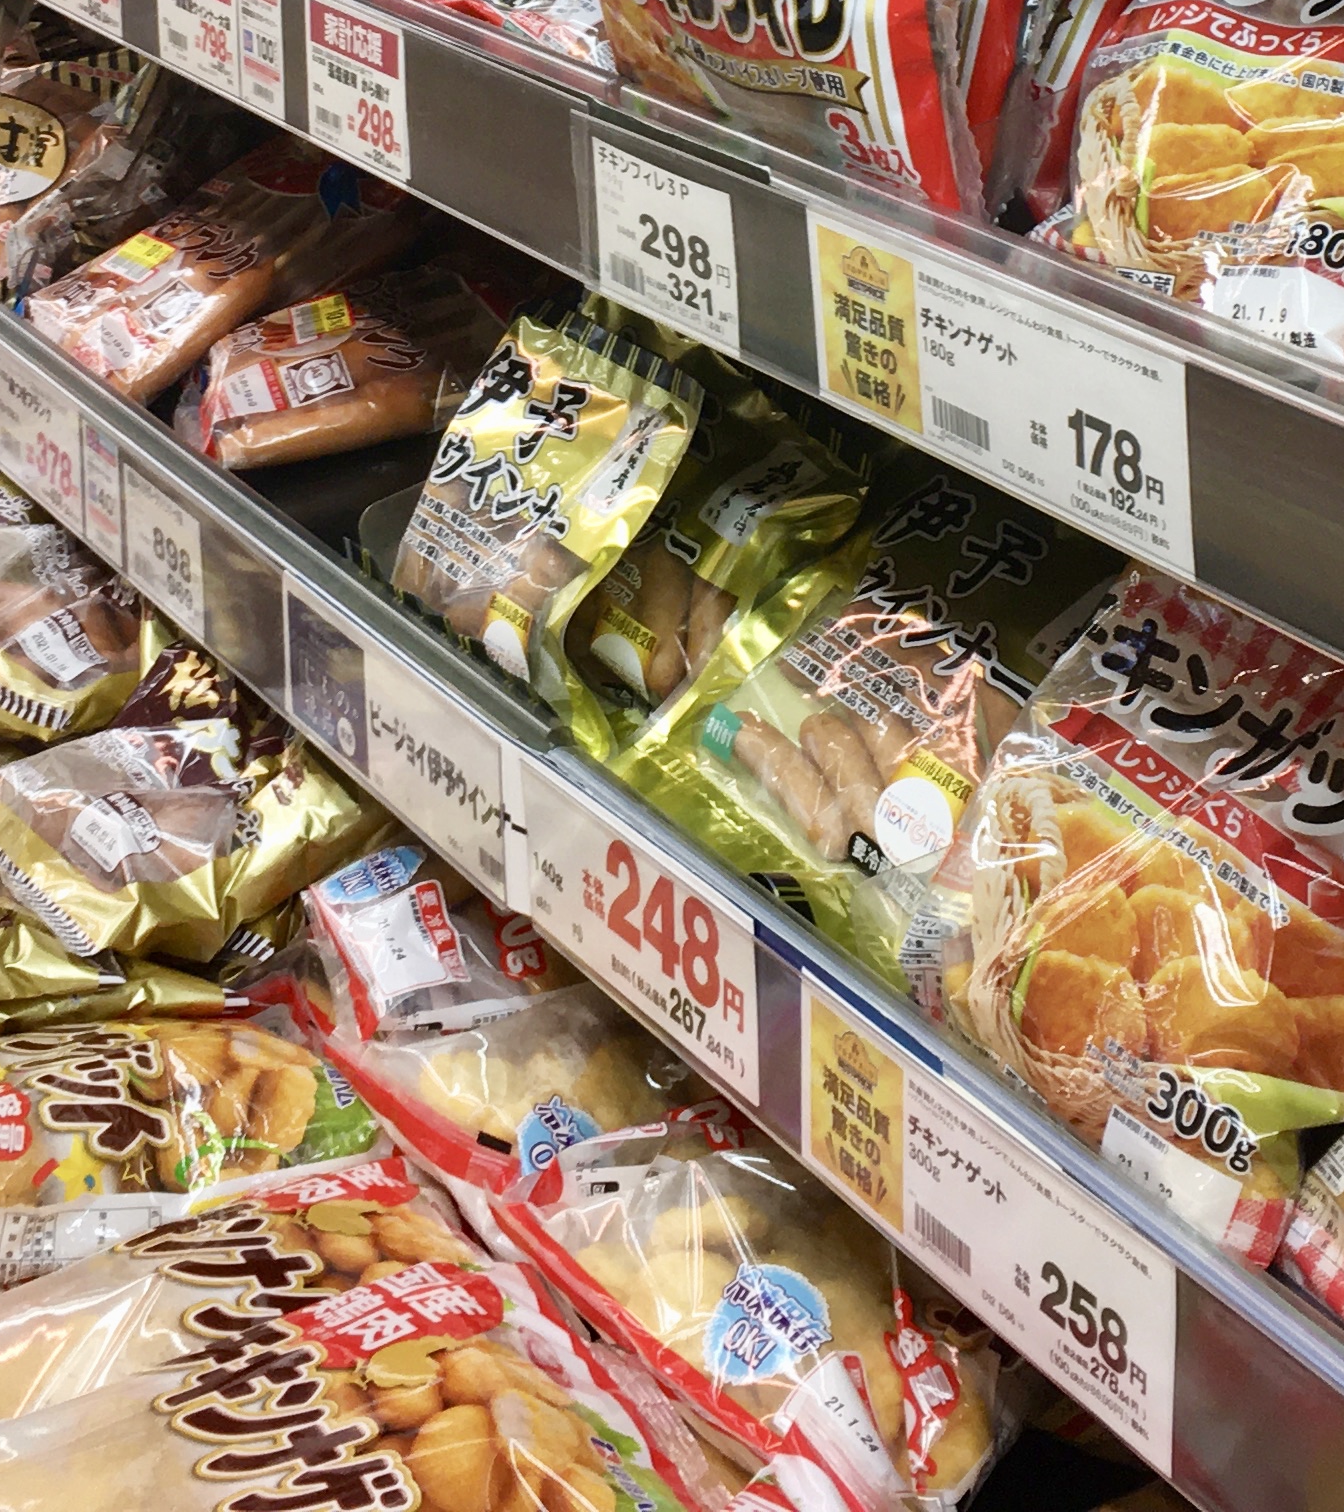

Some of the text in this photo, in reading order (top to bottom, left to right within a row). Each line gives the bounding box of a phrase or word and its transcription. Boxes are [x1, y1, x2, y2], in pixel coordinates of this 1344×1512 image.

[323, 11, 384, 68] 家計応援
[1148, 3, 1324, 56] レンジでふっくら
[832, 290, 905, 348] 満足品質
[919, 306, 1019, 366] チキンナゲット
[844, 328, 898, 376] 驚きの
[922, 335, 956, 368] 180g
[856, 367, 893, 410] 価格
[822, 1062, 891, 1145] 満足品質
[1146, 1070, 1255, 1174] 300g
[830, 1104, 882, 1167] 驚きの
[907, 1113, 1008, 1205] チキンナゲット
[907, 1141, 942, 1184] 300g
[839, 1145, 874, 1198] 価格
